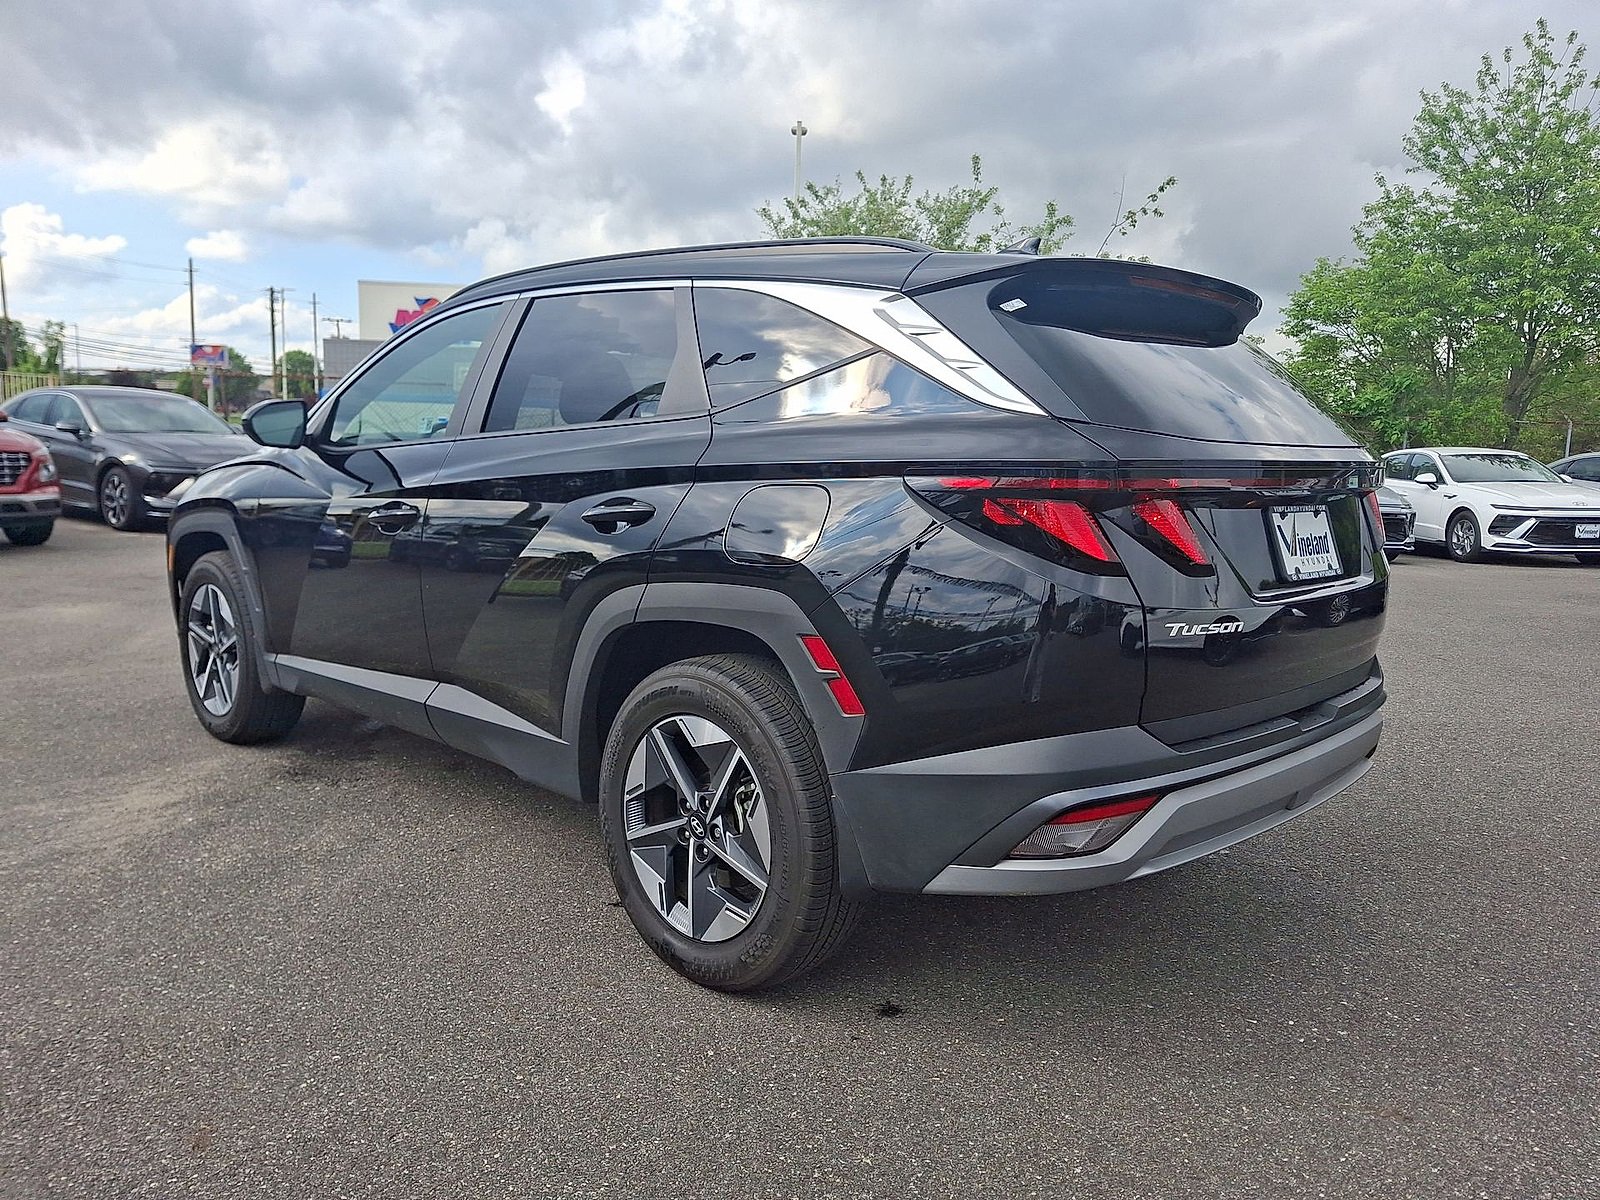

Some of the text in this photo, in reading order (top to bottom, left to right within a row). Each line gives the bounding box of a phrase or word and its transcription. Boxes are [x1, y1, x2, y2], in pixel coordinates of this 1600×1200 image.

[1277, 514, 1330, 557] Vineland
[1301, 555, 1334, 566] HYUNDAI
[1164, 621, 1245, 637] Tucson
